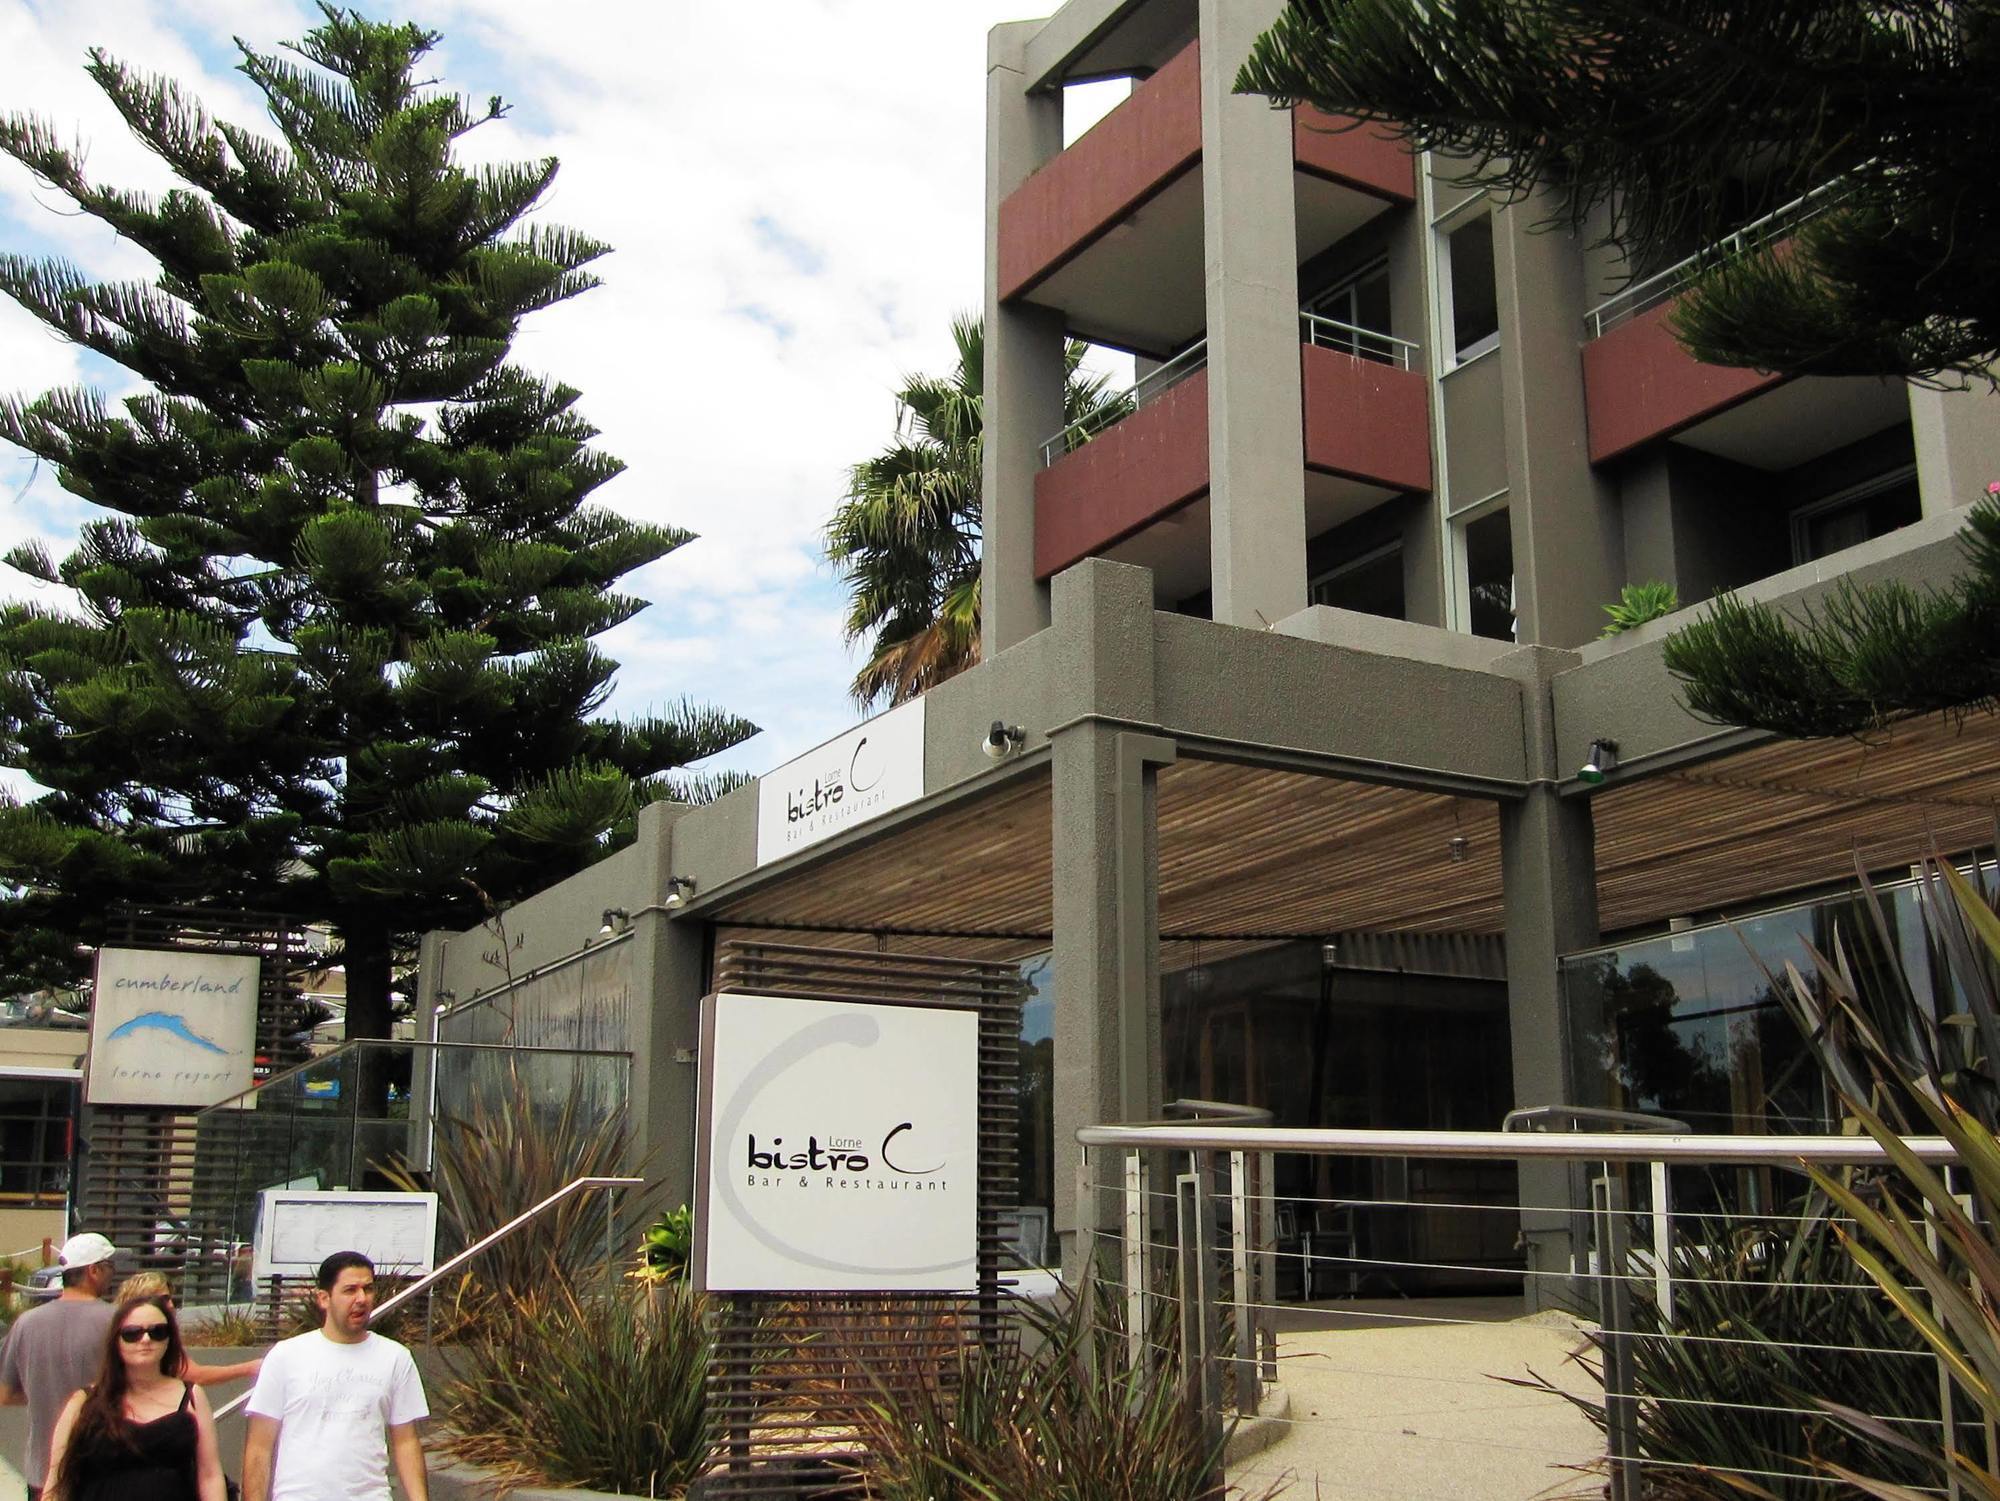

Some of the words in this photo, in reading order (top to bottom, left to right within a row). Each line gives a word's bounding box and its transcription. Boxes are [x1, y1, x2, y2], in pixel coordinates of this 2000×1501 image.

[787, 778, 844, 824] bistro
[850, 737, 887, 792] C
[824, 769, 842, 784] Lorne
[787, 828, 802, 842] Bar
[822, 789, 886, 824] Restaurant
[115, 973, 244, 995] cumberland
[748, 1133, 869, 1172] bistro
[881, 1122, 946, 1175] C
[828, 1135, 863, 1149] Lorne
[747, 1174, 782, 1188] Bar
[799, 1176, 809, 1188] &
[826, 1176, 947, 1191] Restaurant
